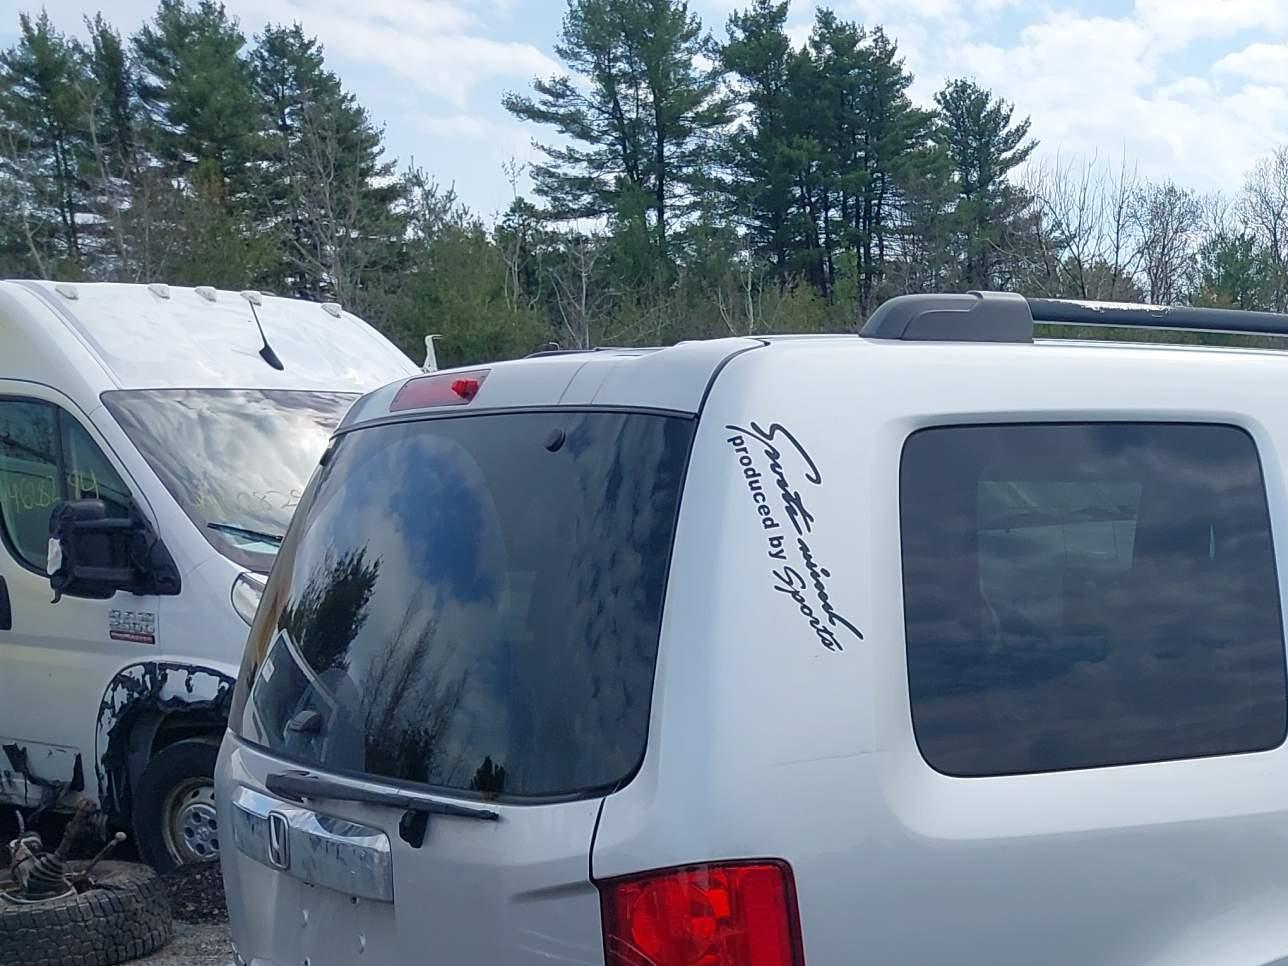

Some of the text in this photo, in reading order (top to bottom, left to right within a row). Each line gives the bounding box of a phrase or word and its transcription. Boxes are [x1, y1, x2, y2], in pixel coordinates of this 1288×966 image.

[727, 435, 843, 652] produced by Sports
